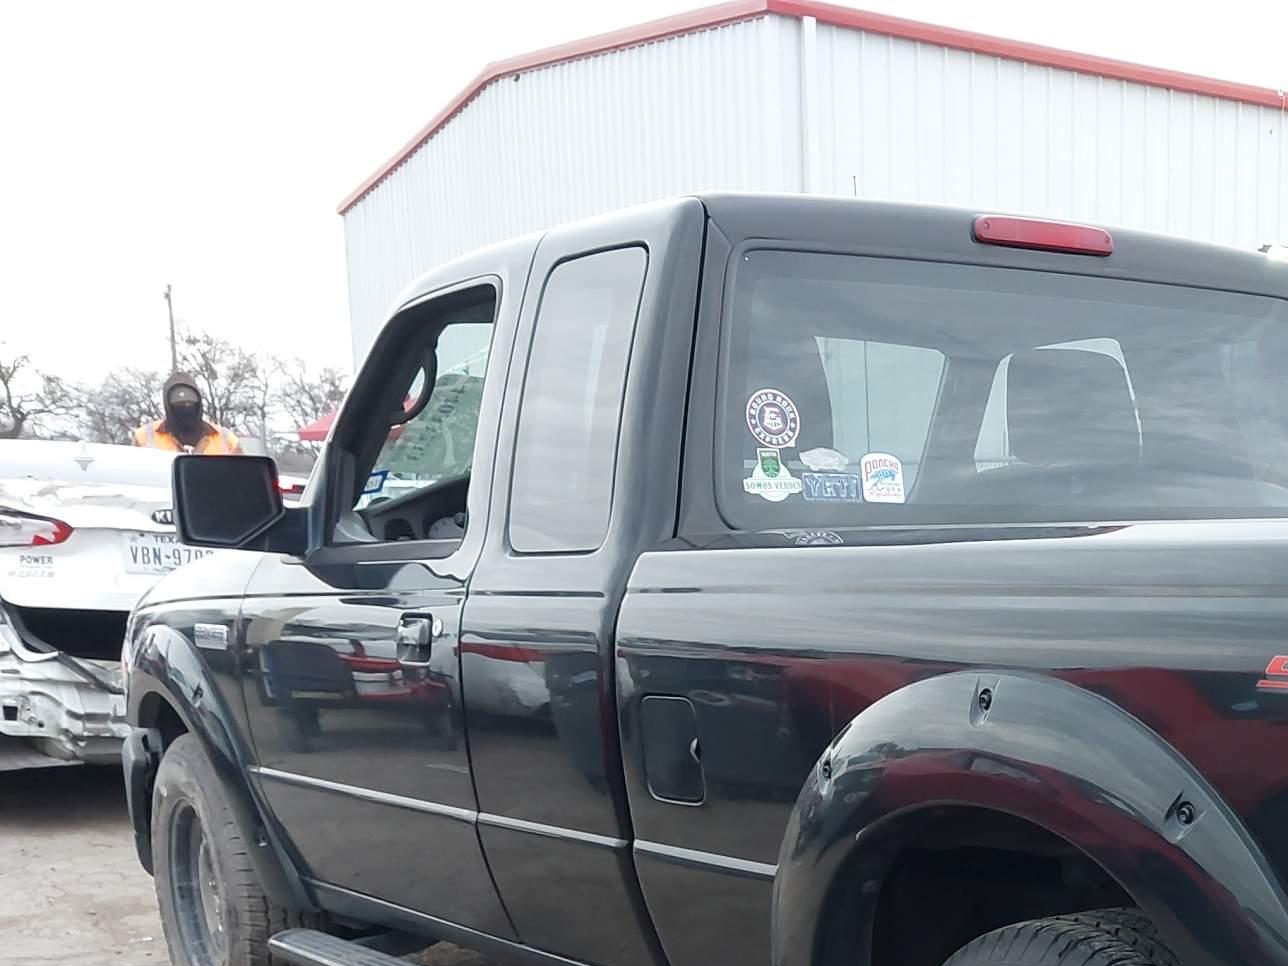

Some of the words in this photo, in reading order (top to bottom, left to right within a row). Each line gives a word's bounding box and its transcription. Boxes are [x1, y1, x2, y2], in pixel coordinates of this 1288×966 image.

[749, 392, 774, 416] ROUND
[754, 427, 794, 445] EXPRESS
[745, 481, 773, 490] SOMOS
[805, 478, 857, 498] YETI
[19, 554, 54, 565] POWER
